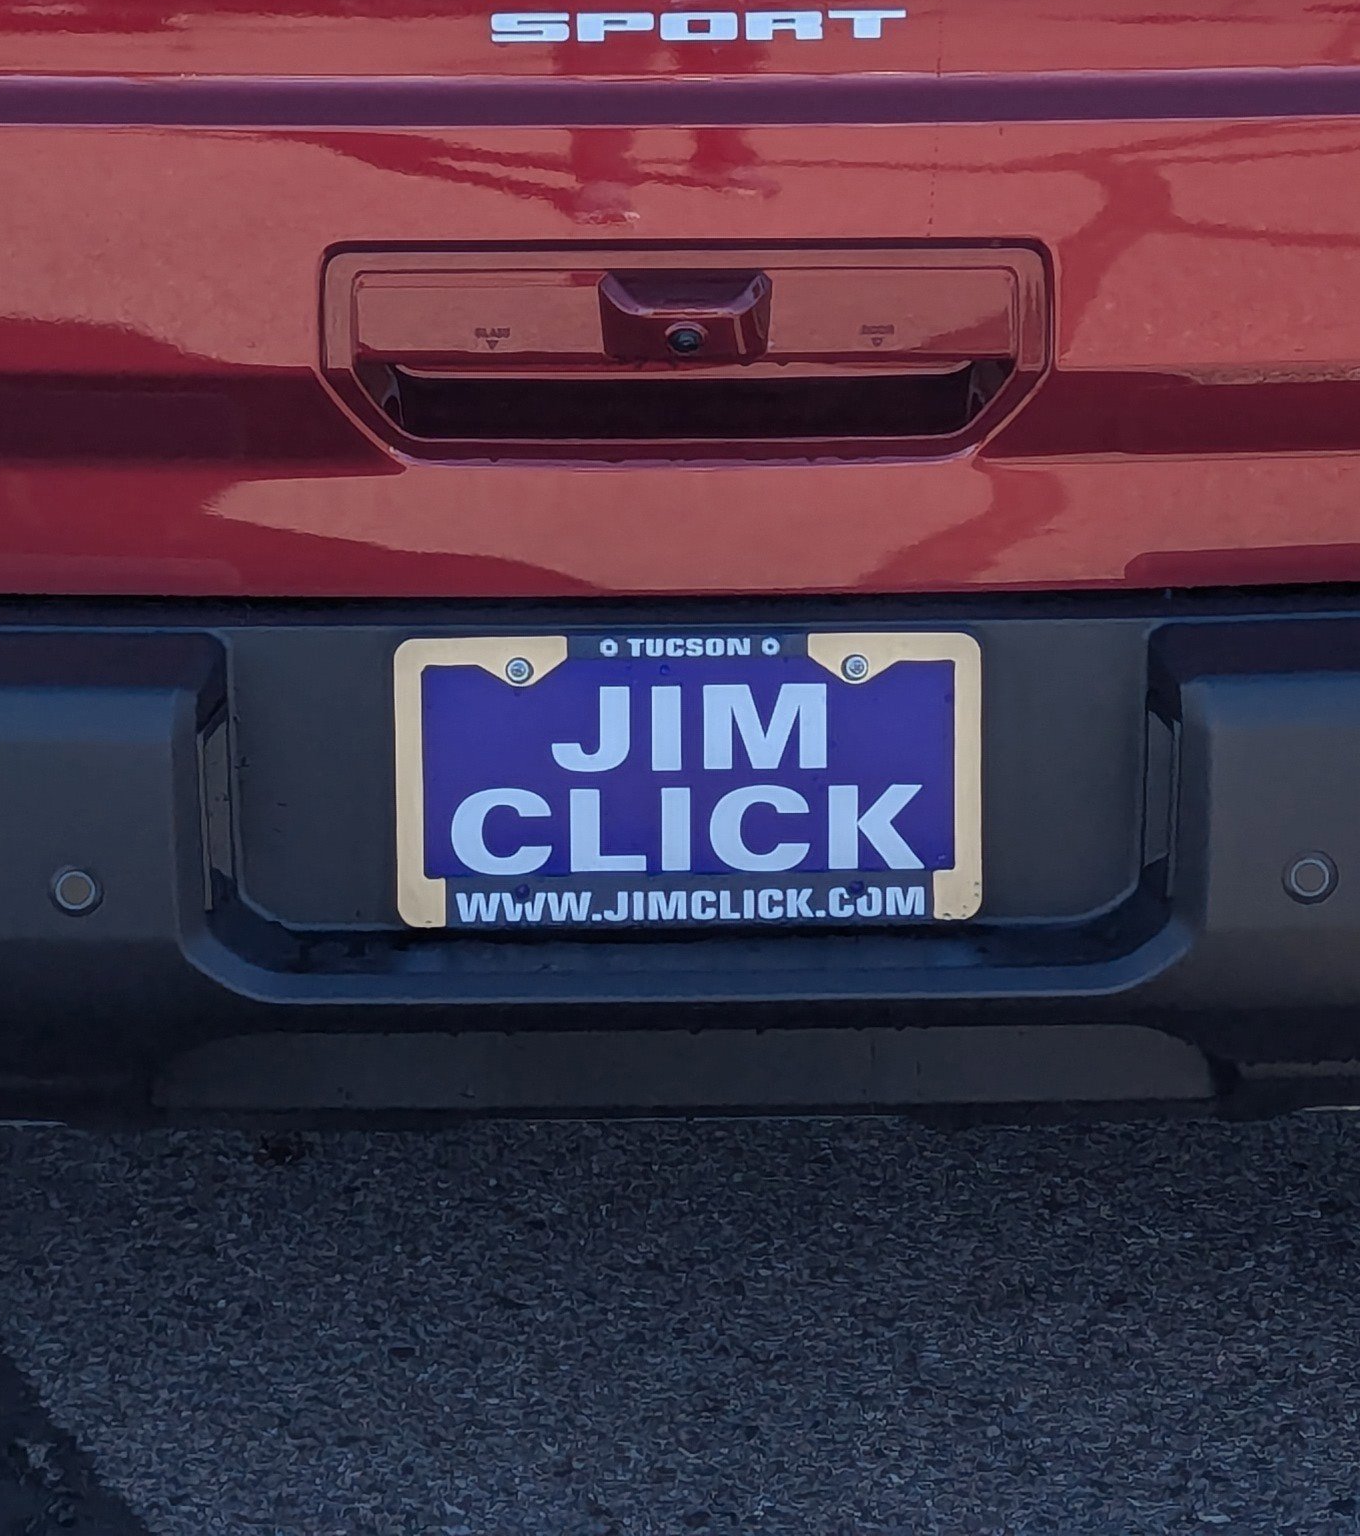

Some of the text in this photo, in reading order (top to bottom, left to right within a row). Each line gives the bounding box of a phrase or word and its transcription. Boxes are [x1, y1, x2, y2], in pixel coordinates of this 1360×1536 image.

[490, 9, 906, 42] SPORT
[627, 638, 751, 657] TUCSON
[551, 683, 827, 772] JIM
[450, 784, 925, 875] CLICK
[456, 886, 926, 923] WWW.JIMCLICK.COM
